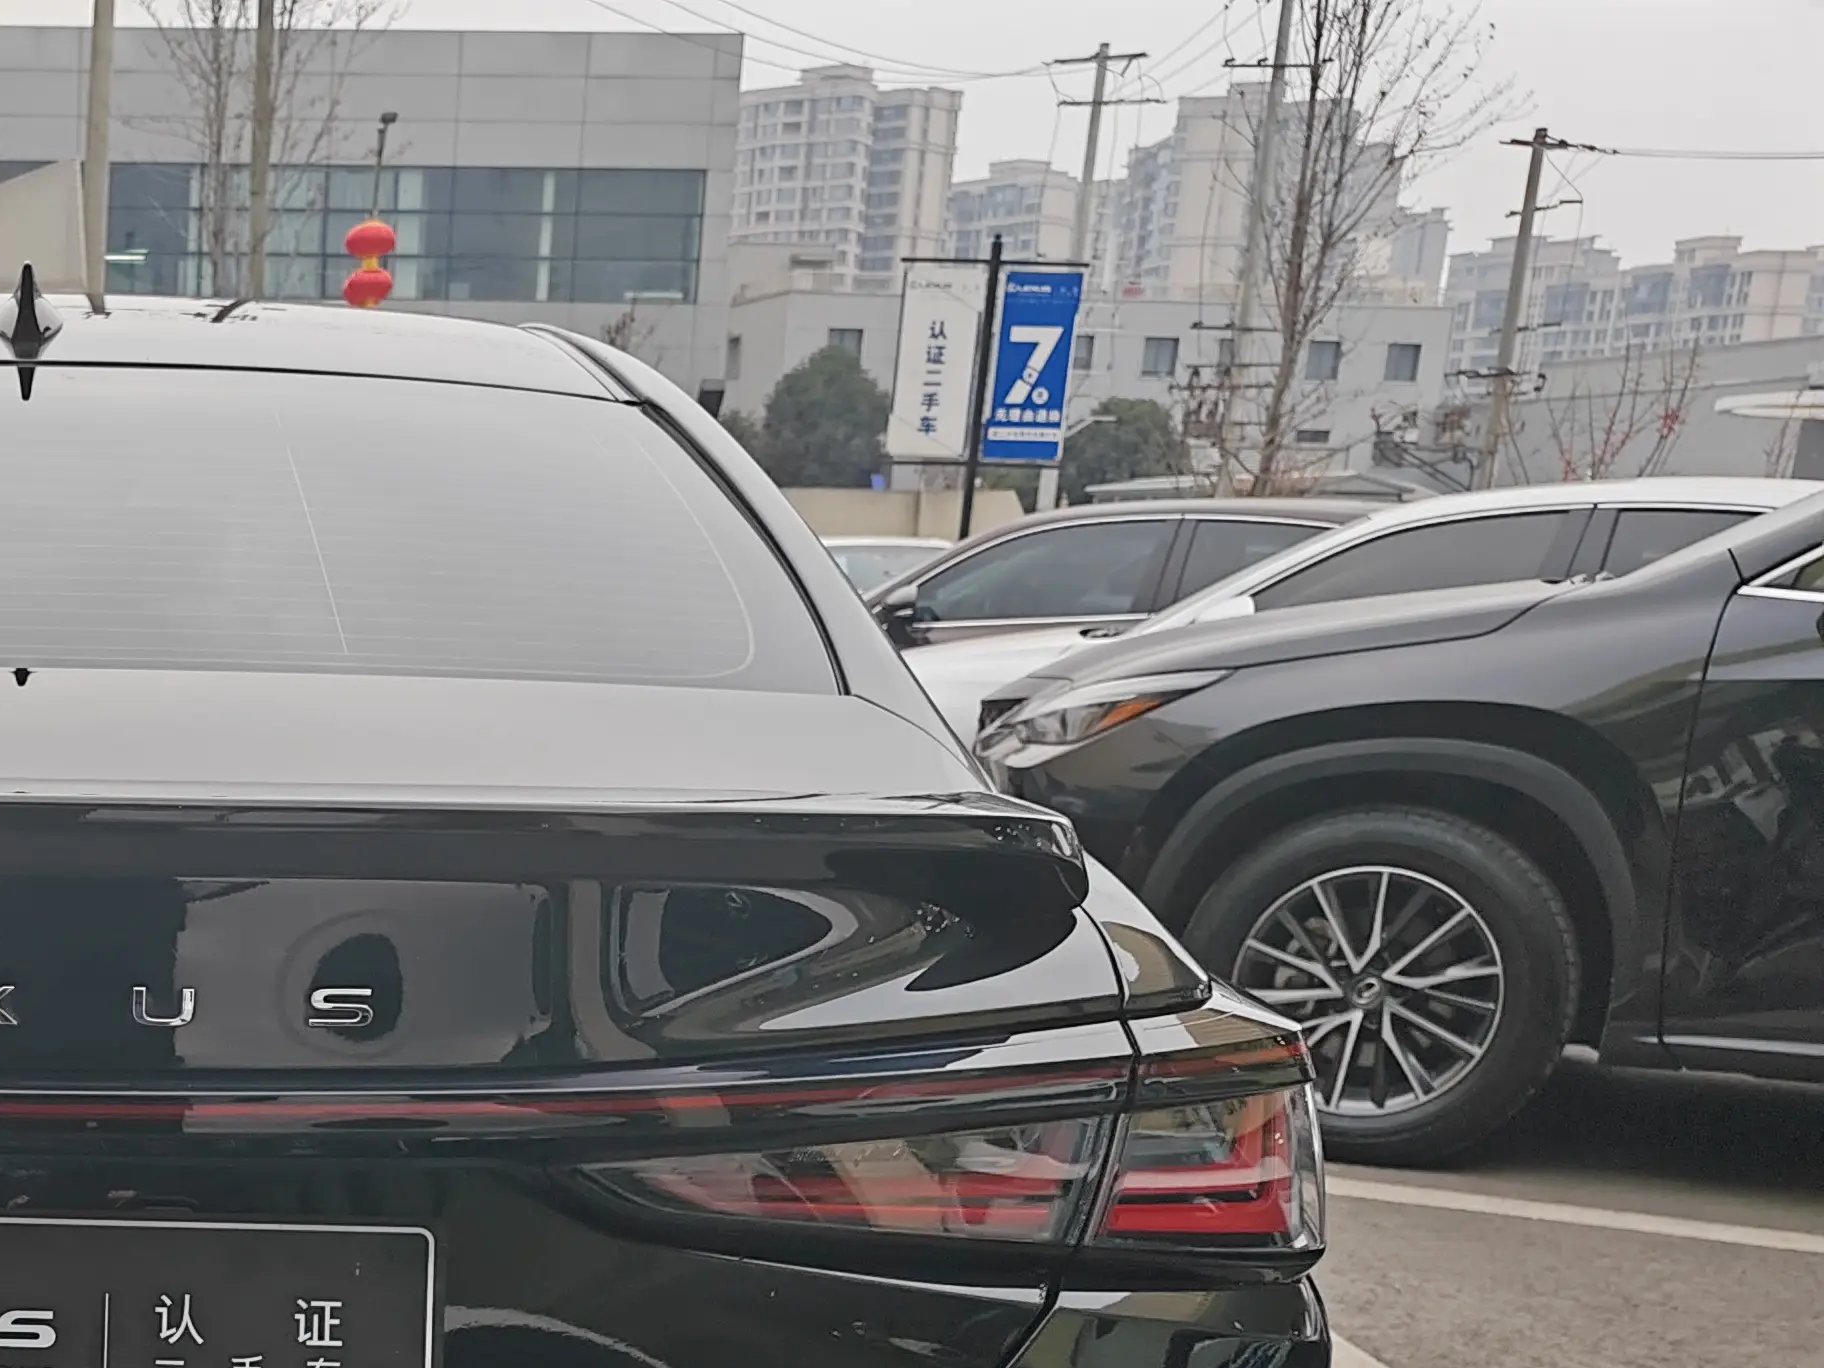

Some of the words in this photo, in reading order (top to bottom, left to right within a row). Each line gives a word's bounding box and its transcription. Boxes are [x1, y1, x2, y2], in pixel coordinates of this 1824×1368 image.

[917, 320, 947, 436] 认证二手车
[154, 1293, 343, 1347] 认证
